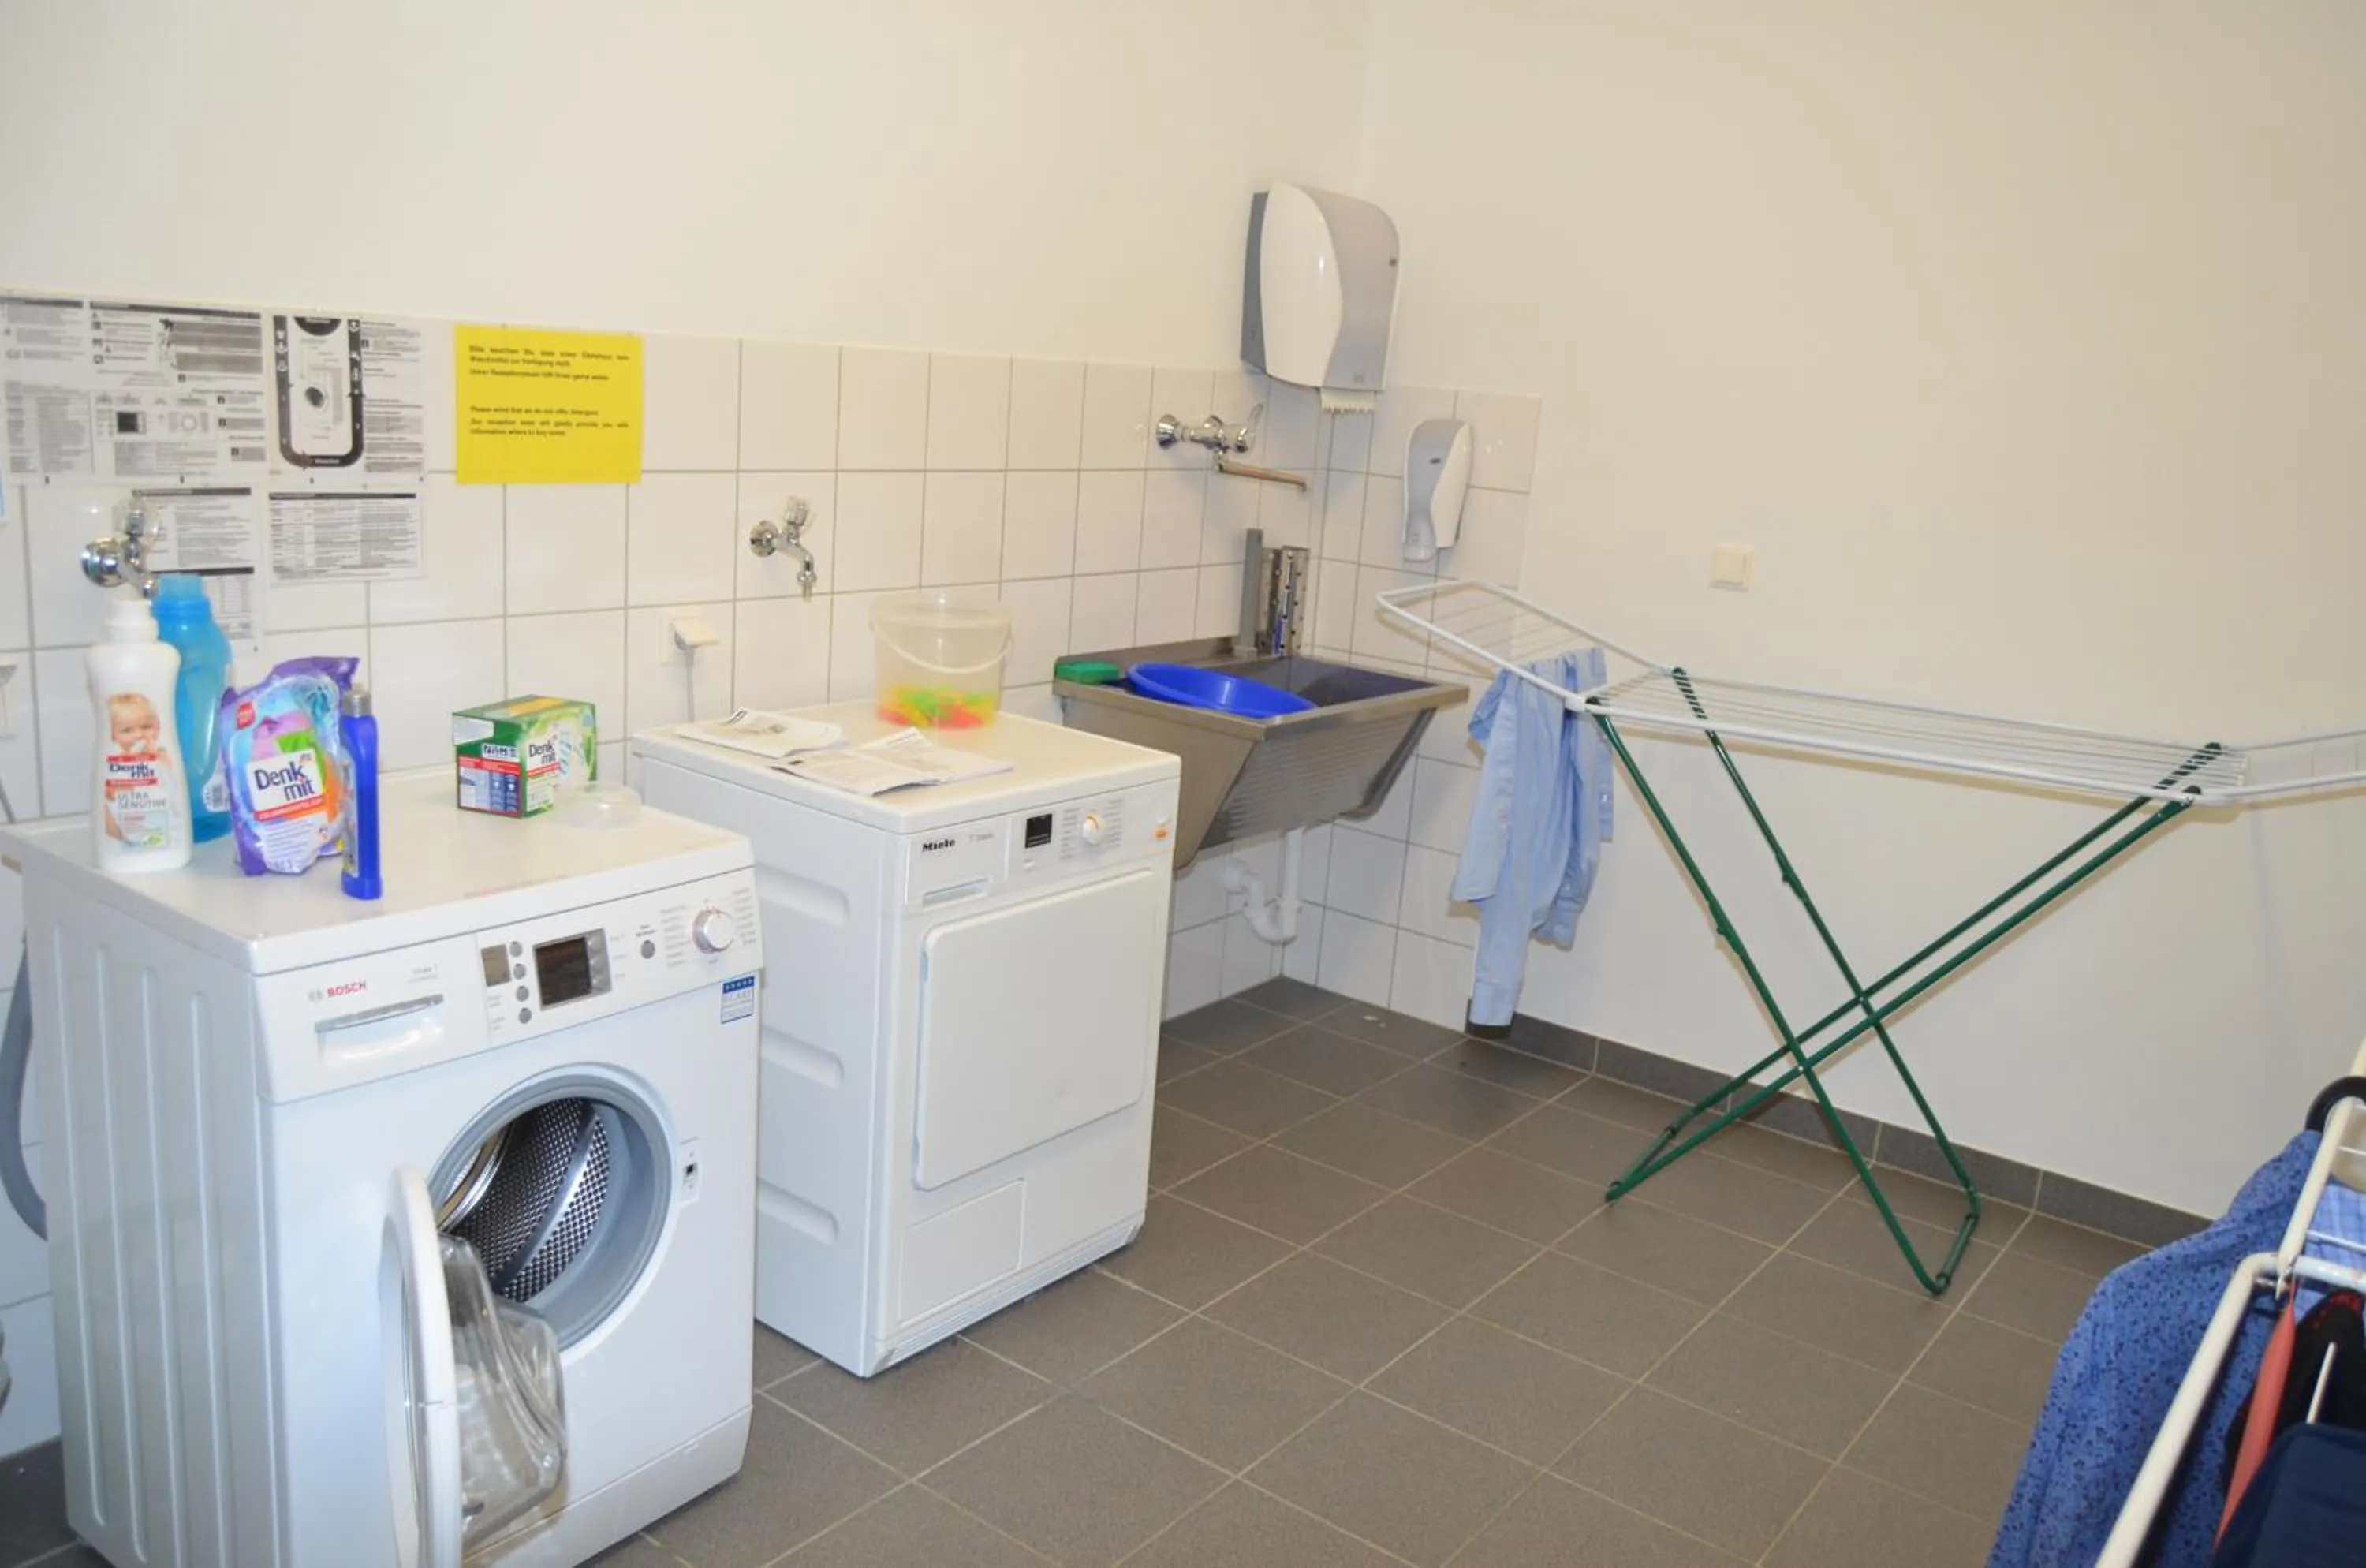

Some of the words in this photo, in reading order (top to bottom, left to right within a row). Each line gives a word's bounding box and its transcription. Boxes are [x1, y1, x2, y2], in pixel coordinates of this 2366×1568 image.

[528, 740, 554, 758] Denk
[110, 763, 149, 772] Denk
[252, 760, 306, 791] Denk
[282, 779, 316, 802] mit
[922, 838, 956, 853] Miele
[327, 980, 368, 999] BOSCH
